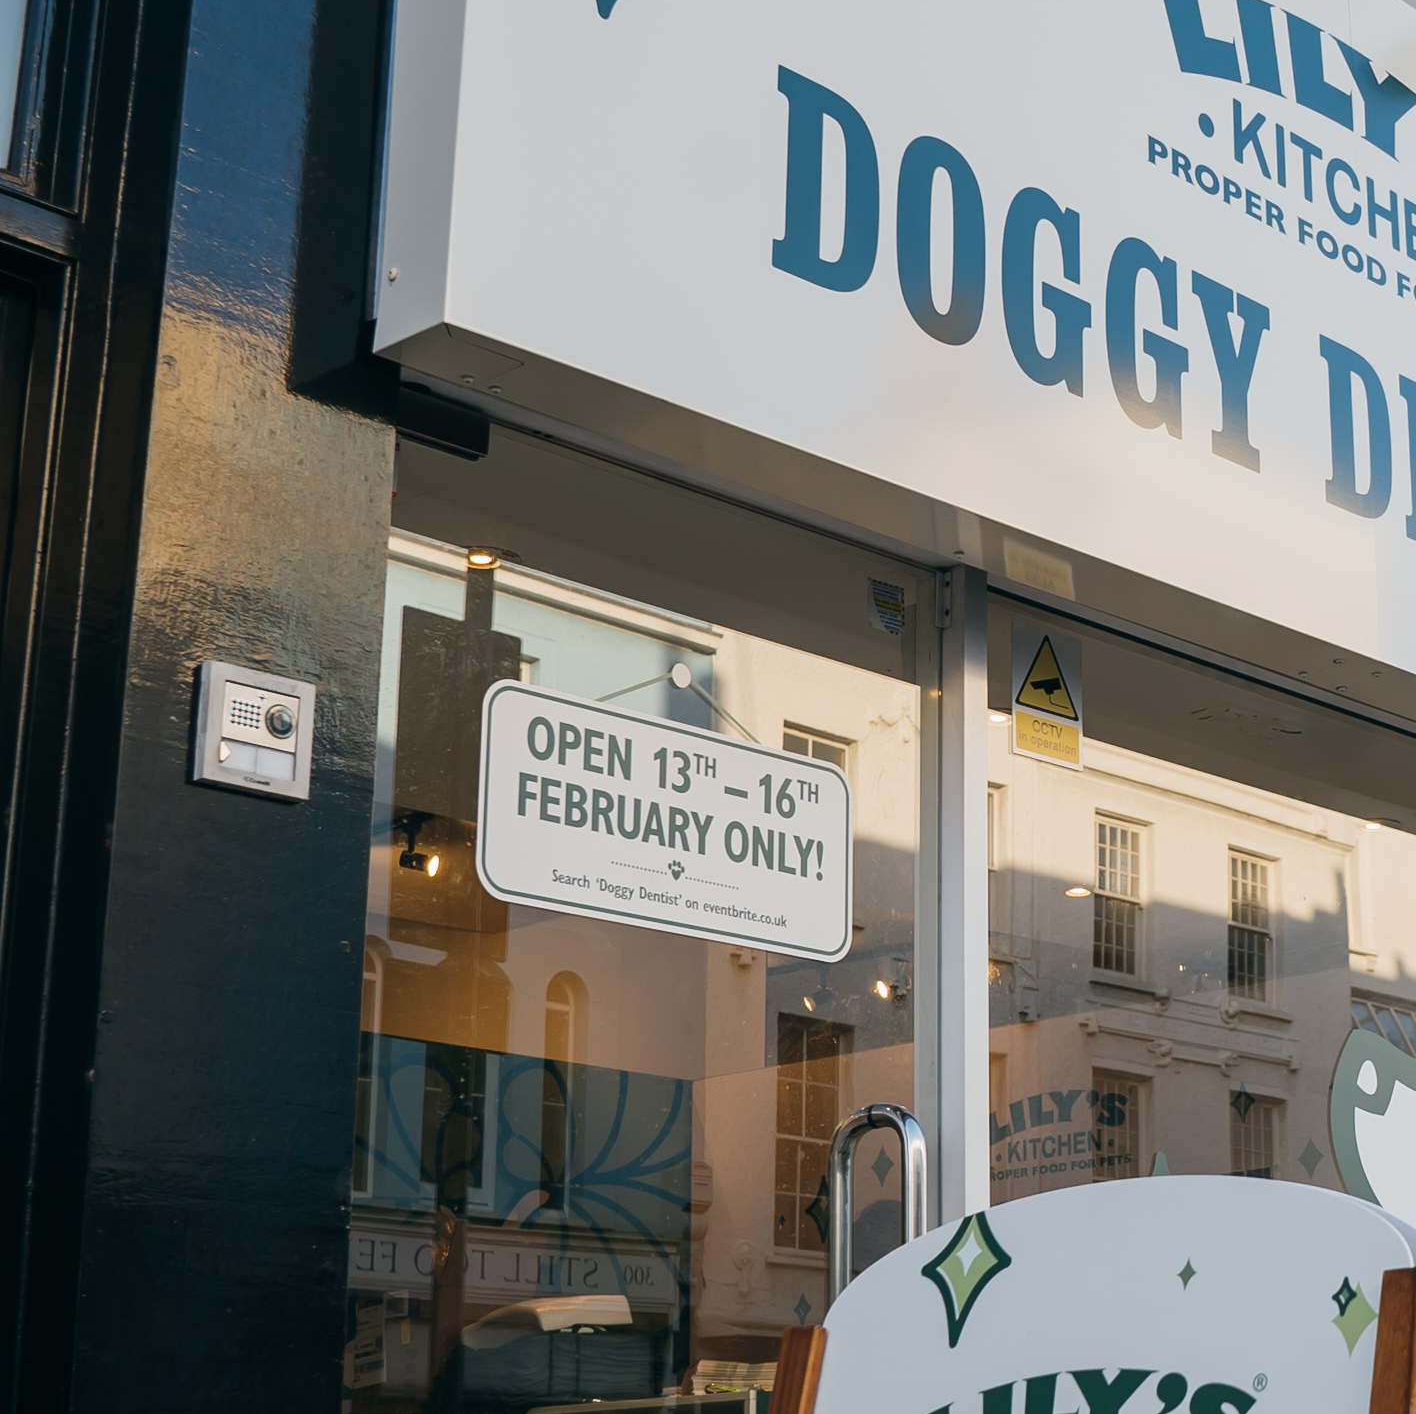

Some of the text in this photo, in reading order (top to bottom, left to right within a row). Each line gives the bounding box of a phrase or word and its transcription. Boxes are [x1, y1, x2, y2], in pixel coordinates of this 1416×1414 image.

[1146, 134, 1287, 237] PROPER
[1296, 217, 1388, 290] FOOD
[771, 64, 1271, 473] DOGGY
[527, 715, 632, 782] OPEN
[1018, 729, 1077, 757] in operation
[1032, 719, 1063, 739] CCTV
[517, 773, 825, 884] FEBRUARY ONLY!
[551, 867, 591, 892] Search
[684, 896, 699, 911] on
[702, 899, 789, 930] eventbrite.co.uk
[1006, 1129, 1102, 1164] KITCHEN
[1032, 1160, 1068, 1178] FOOD
[1071, 1157, 1095, 1173] FOR
[1100, 1153, 1132, 1167] PETS
